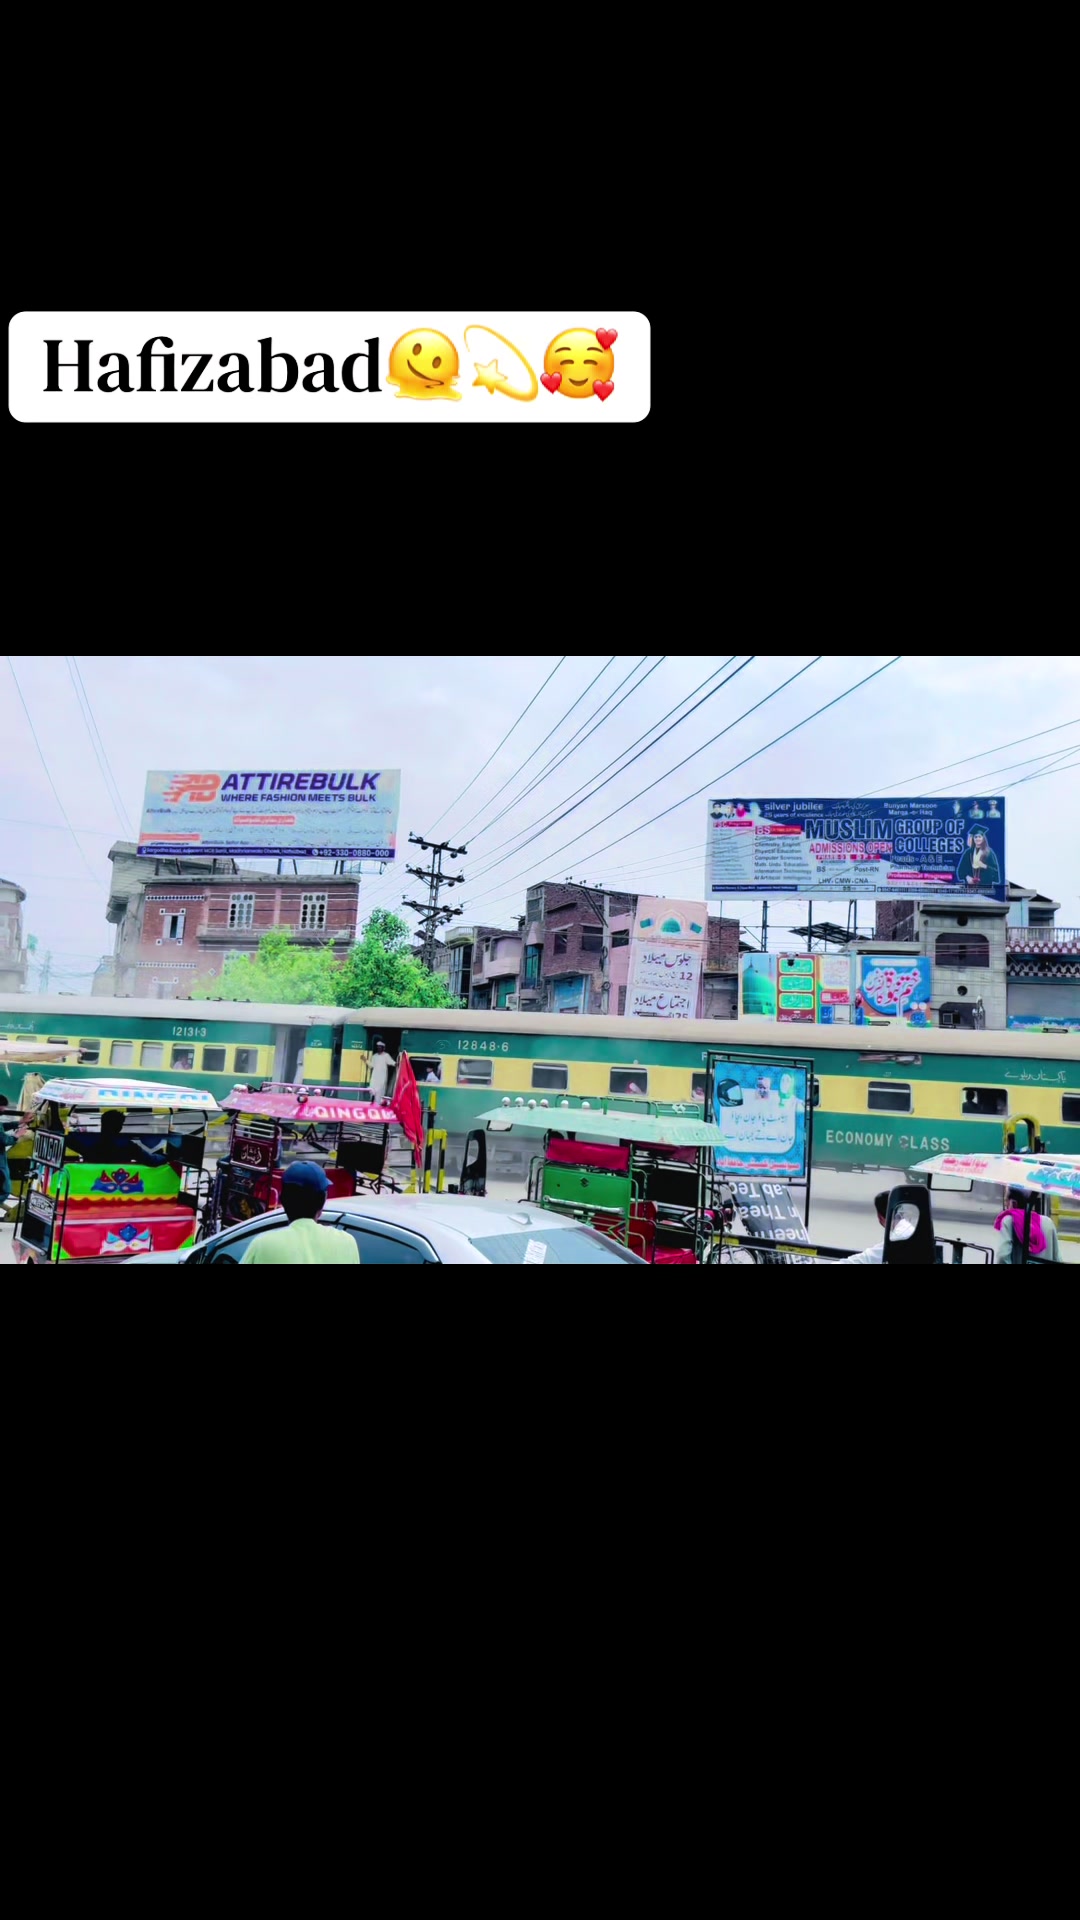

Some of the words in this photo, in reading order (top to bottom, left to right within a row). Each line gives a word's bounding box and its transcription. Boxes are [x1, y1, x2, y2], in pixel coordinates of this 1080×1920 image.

[221, 773, 380, 790] ATTIREBULK
[221, 793, 258, 802] WHERE
[260, 793, 306, 802] FASHION
[308, 793, 345, 802] MEETS
[348, 793, 376, 802] BULK
[764, 802, 791, 811] silver
[792, 802, 824, 812] jubilee
[883, 802, 908, 810] Bunyan
[919, 809, 933, 817] Haq
[804, 818, 893, 840] MUSLIM
[895, 819, 943, 836] GROUP
[944, 819, 965, 836] OF
[809, 841, 865, 853] ADMISSIONS
[866, 841, 893, 854] OPEN
[895, 837, 964, 854] COLLEGES
[816, 865, 826, 873] BS
[641, 952, 666, 965] میلاد
[664, 952, 692, 968] جلوس
[679, 971, 693, 981] 12
[633, 993, 657, 1006] میلاد
[656, 993, 690, 1010] اجتماع
[825, 1129, 894, 1148] ECONOMY
[898, 1134, 951, 1152] CLASS
